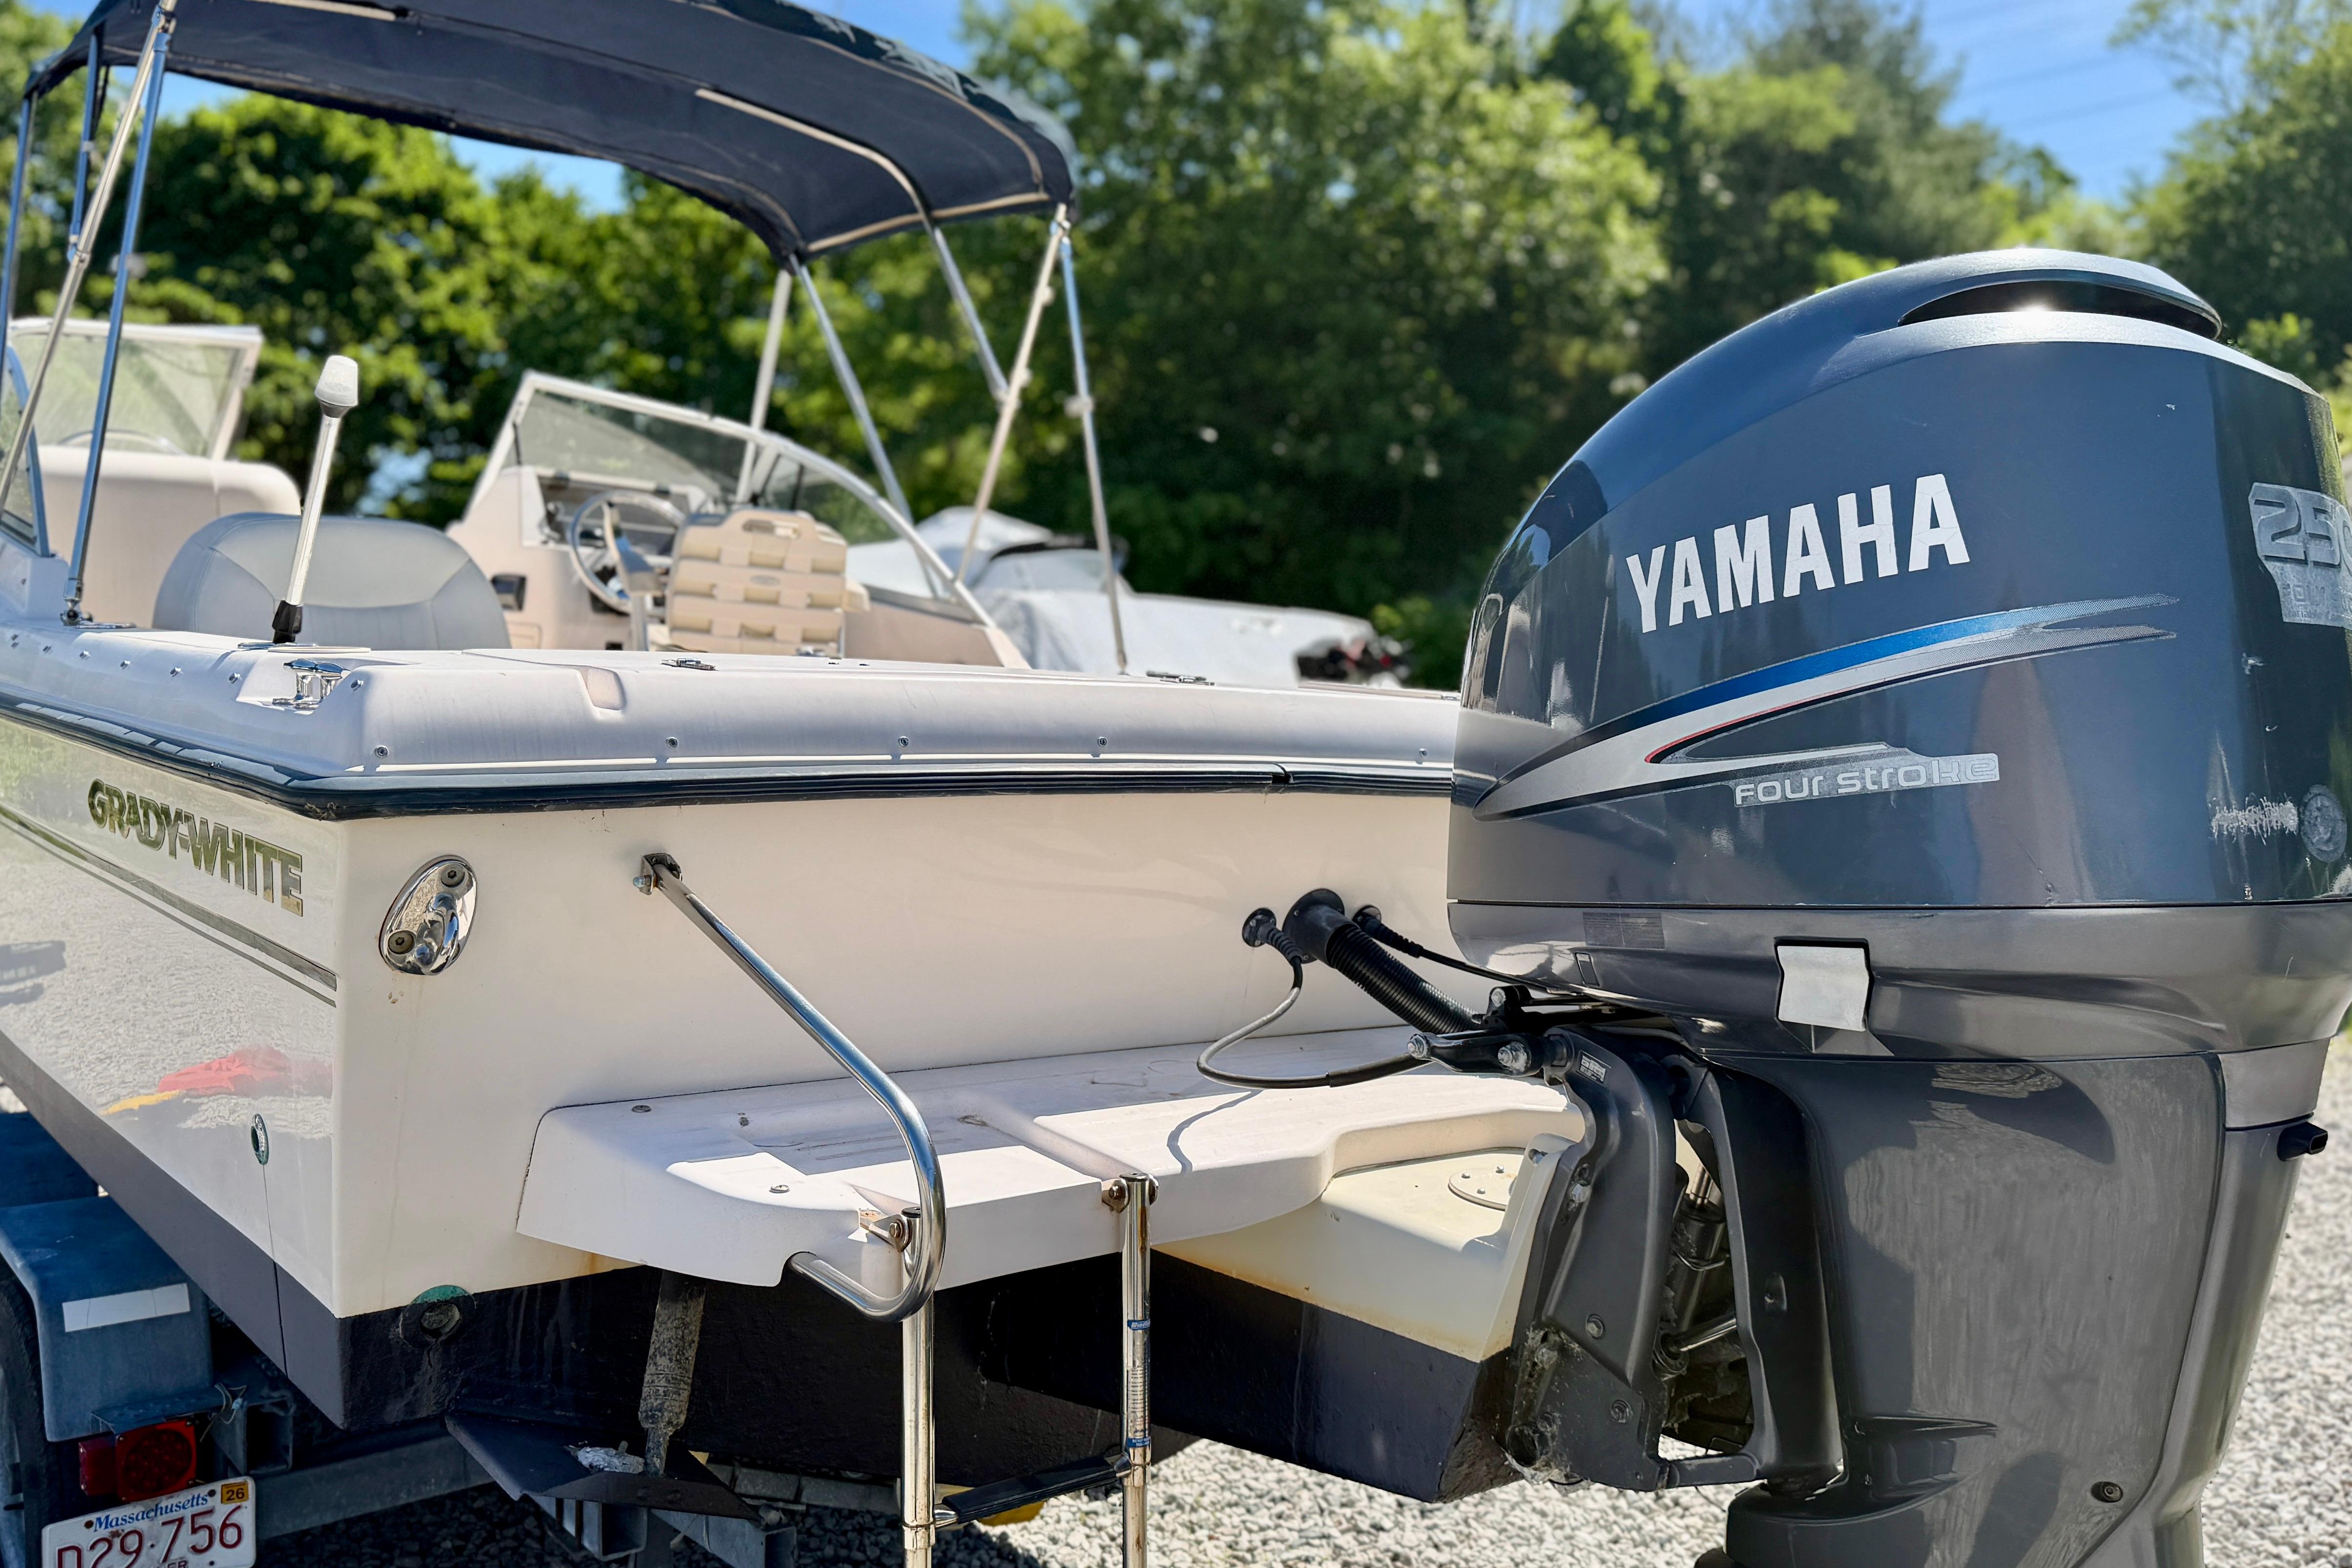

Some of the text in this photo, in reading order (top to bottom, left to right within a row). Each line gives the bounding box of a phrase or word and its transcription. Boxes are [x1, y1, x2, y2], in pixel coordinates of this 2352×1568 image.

[1626, 474, 1970, 633] YAMAHA
[88, 779, 303, 917] GRADY-WHITE
[93, 1492, 209, 1532] Massachusetts
[226, 1487, 245, 1502] 26
[161, 1505, 243, 1563] 756
